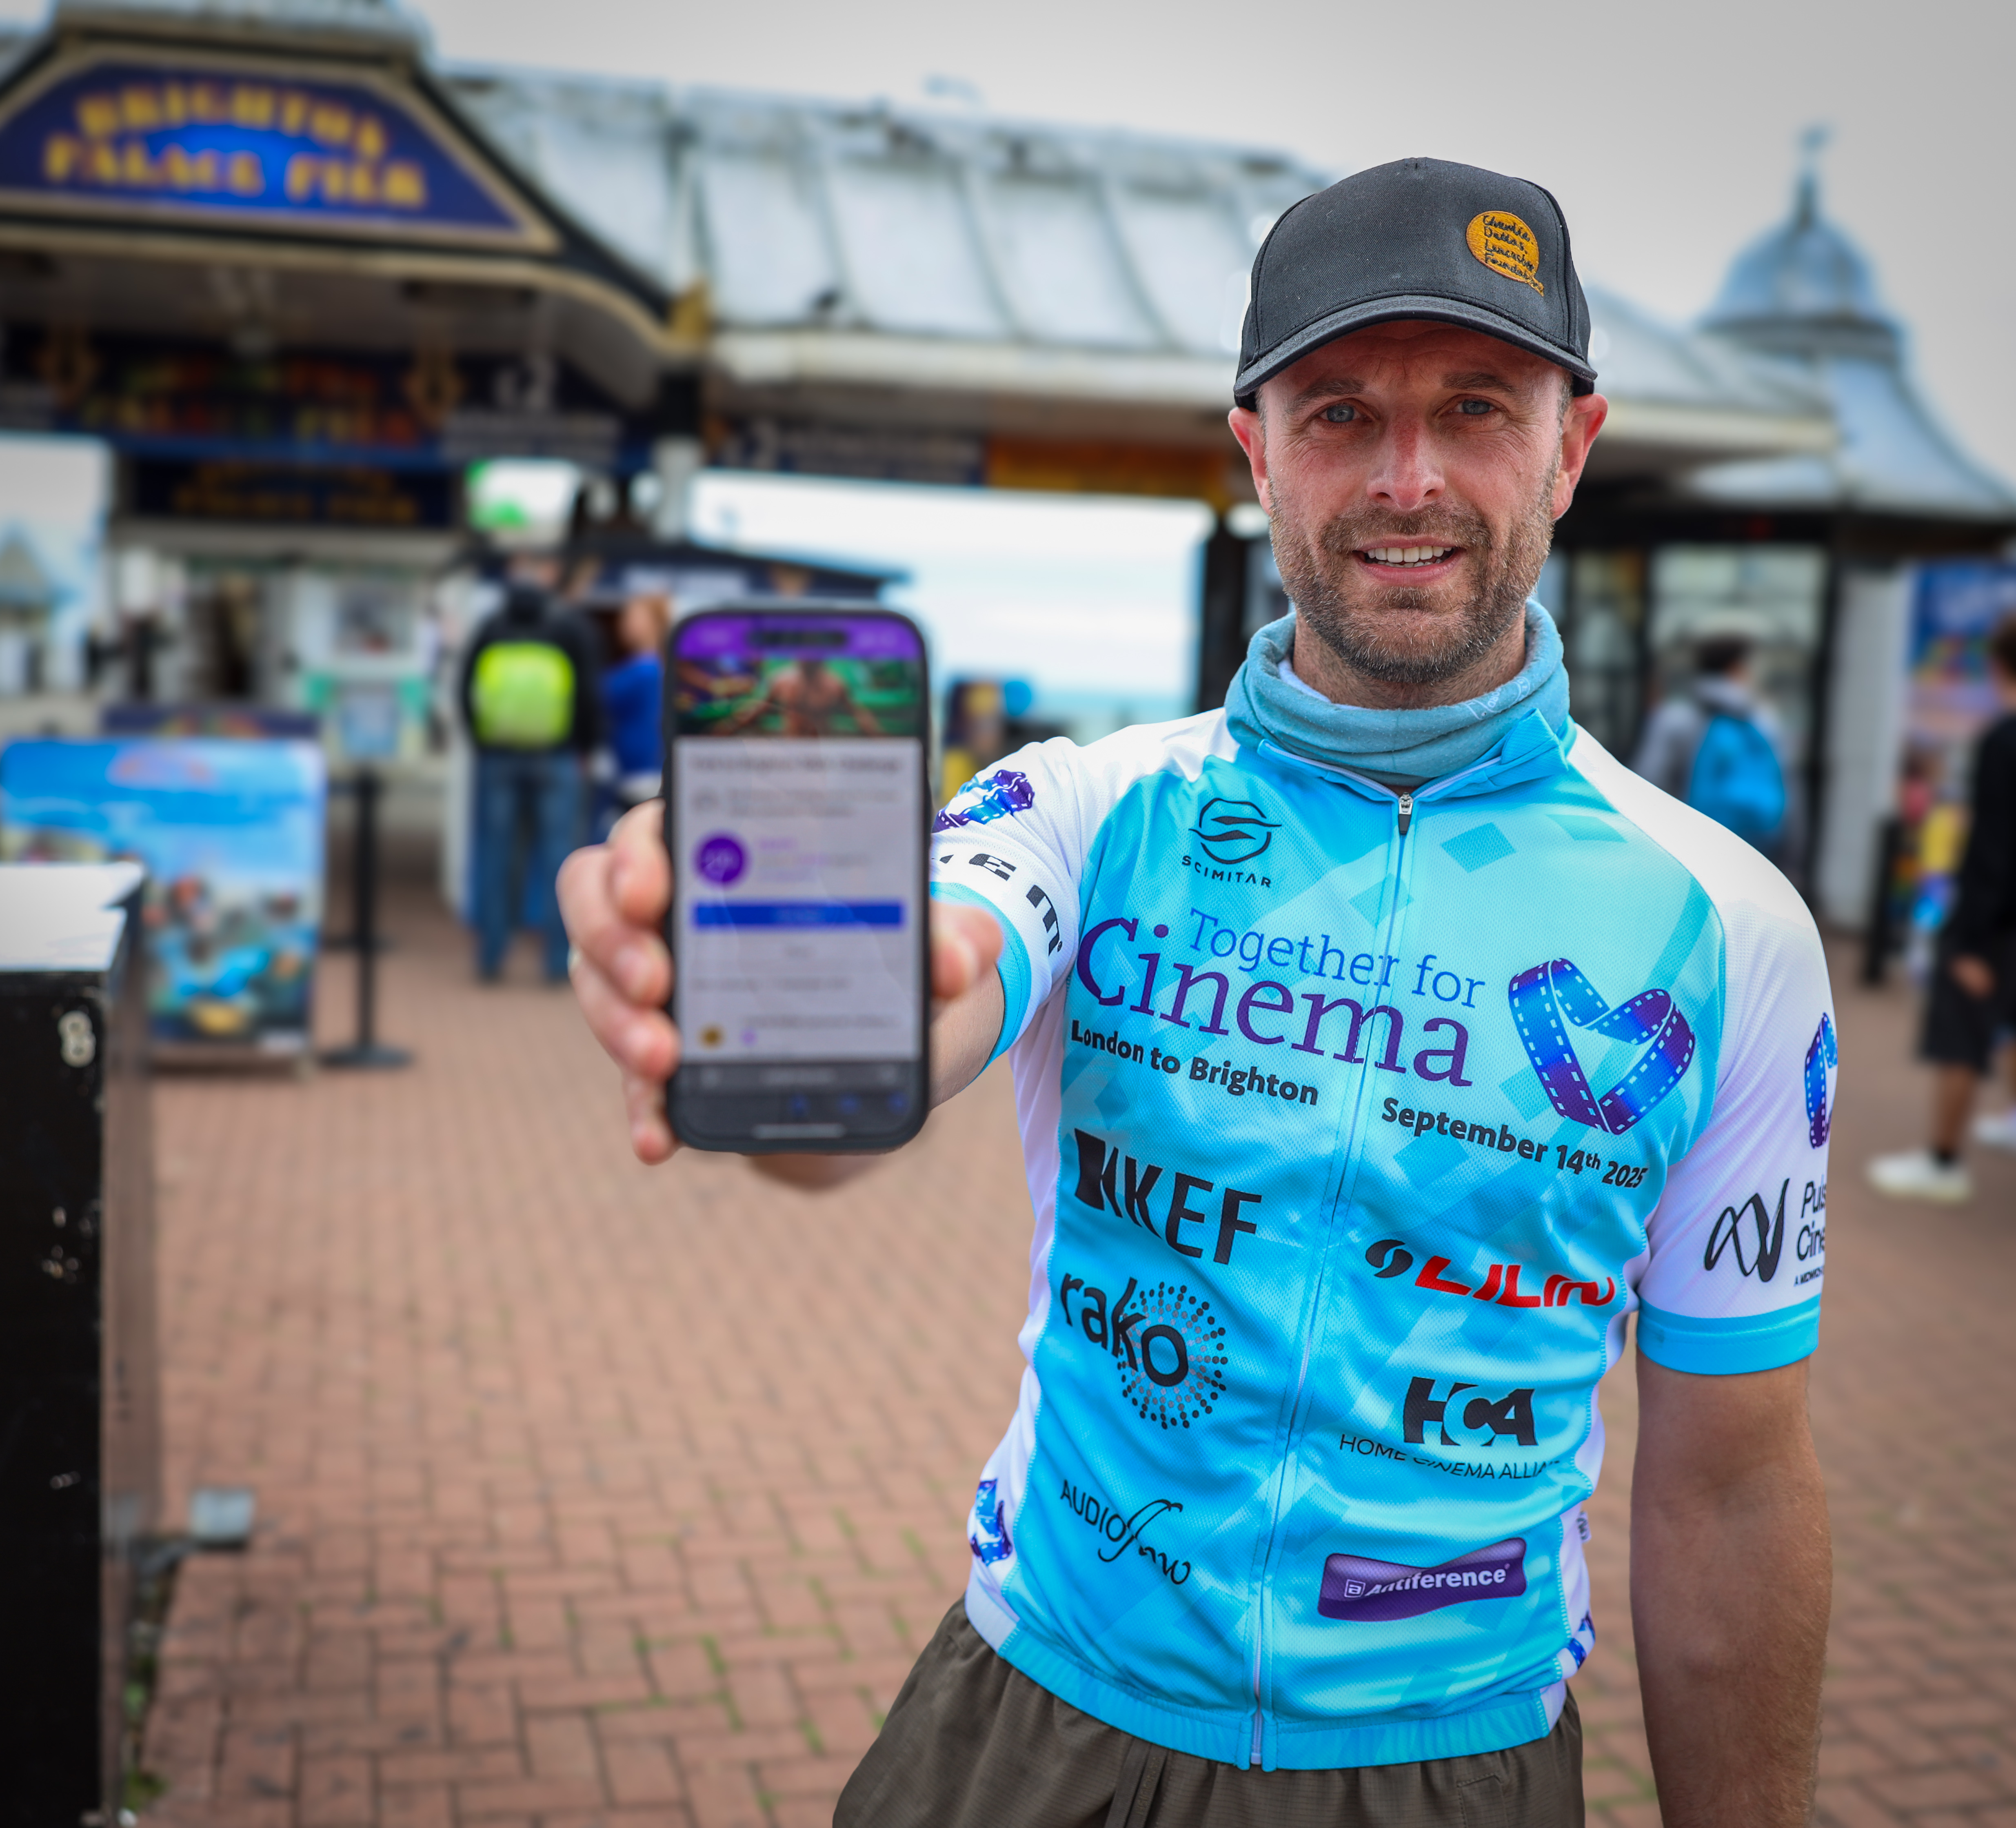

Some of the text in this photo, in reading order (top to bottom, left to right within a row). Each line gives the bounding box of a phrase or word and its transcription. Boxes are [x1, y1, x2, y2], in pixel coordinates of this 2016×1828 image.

[1181, 856, 1271, 888] SCIMITAR
[1076, 917, 1472, 1087] Cinema
[1190, 908, 1485, 1008] Together for
[1071, 1020, 1319, 1106] London to Brighton
[1381, 1098, 1648, 1188] September 14th 2025
[1125, 1156, 1262, 1265] KEF
[1061, 1273, 1188, 1387] rako
[1340, 1434, 1407, 1461] HOME
[1364, 1568, 1506, 1597] Antiference
